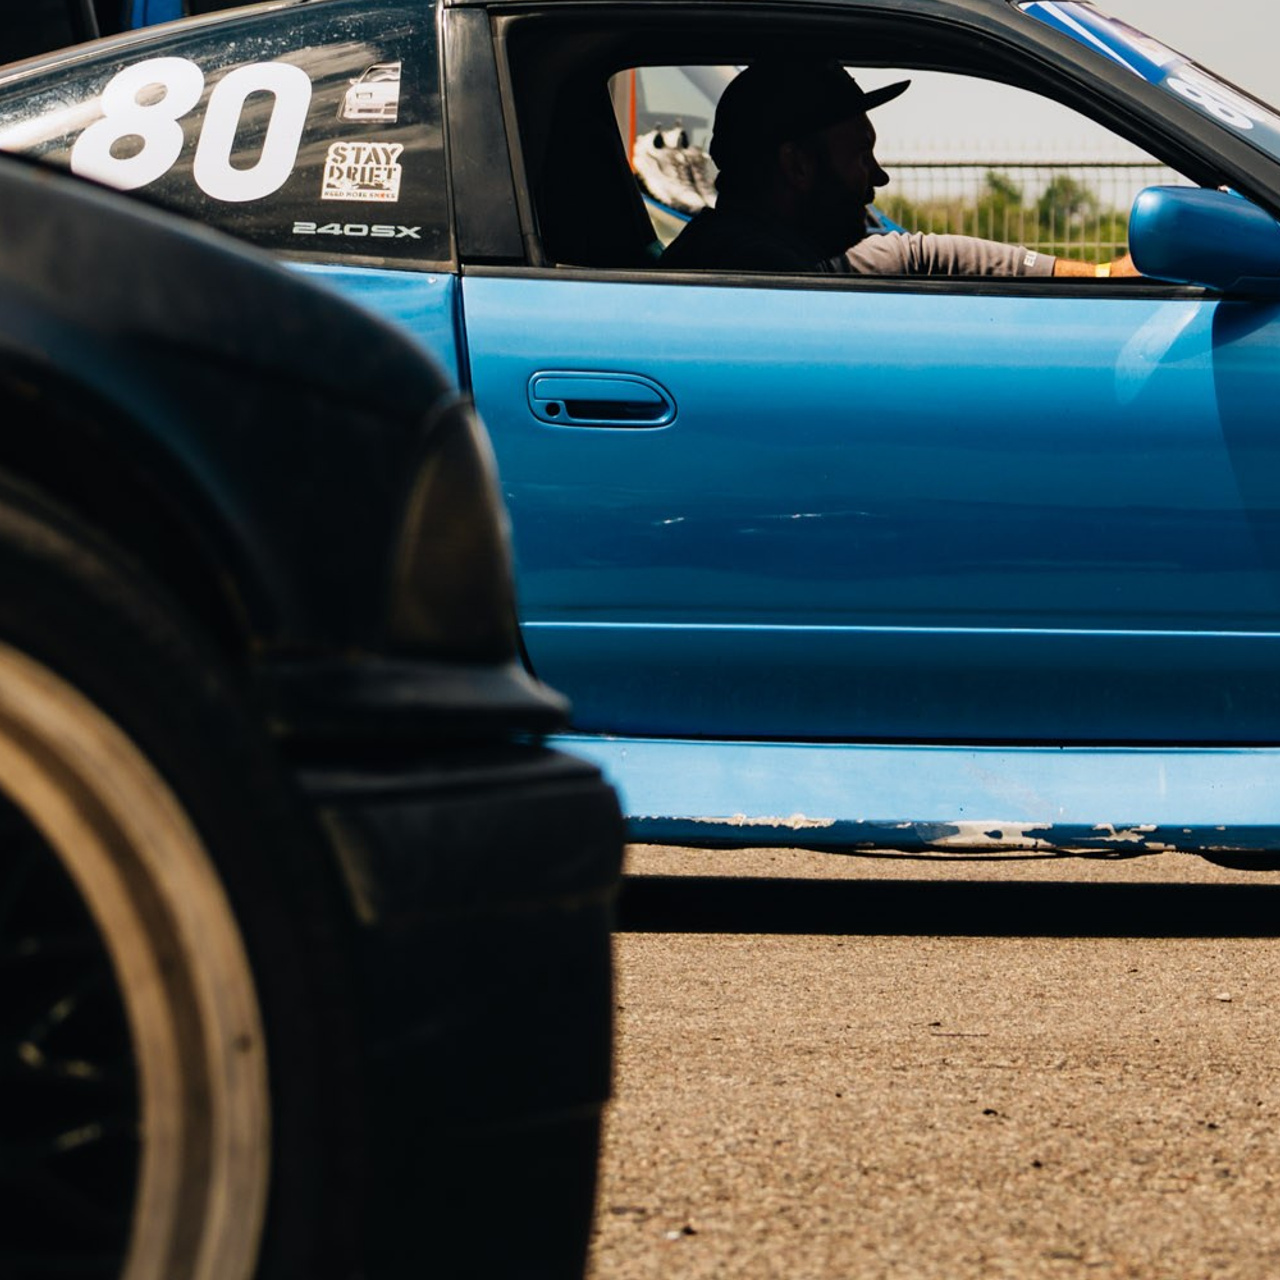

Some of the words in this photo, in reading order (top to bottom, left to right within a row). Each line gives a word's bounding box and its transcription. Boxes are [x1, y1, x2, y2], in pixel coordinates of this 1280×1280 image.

[71, 56, 313, 203] 80
[331, 145, 400, 166] STAY
[292, 221, 422, 239] 240SX
